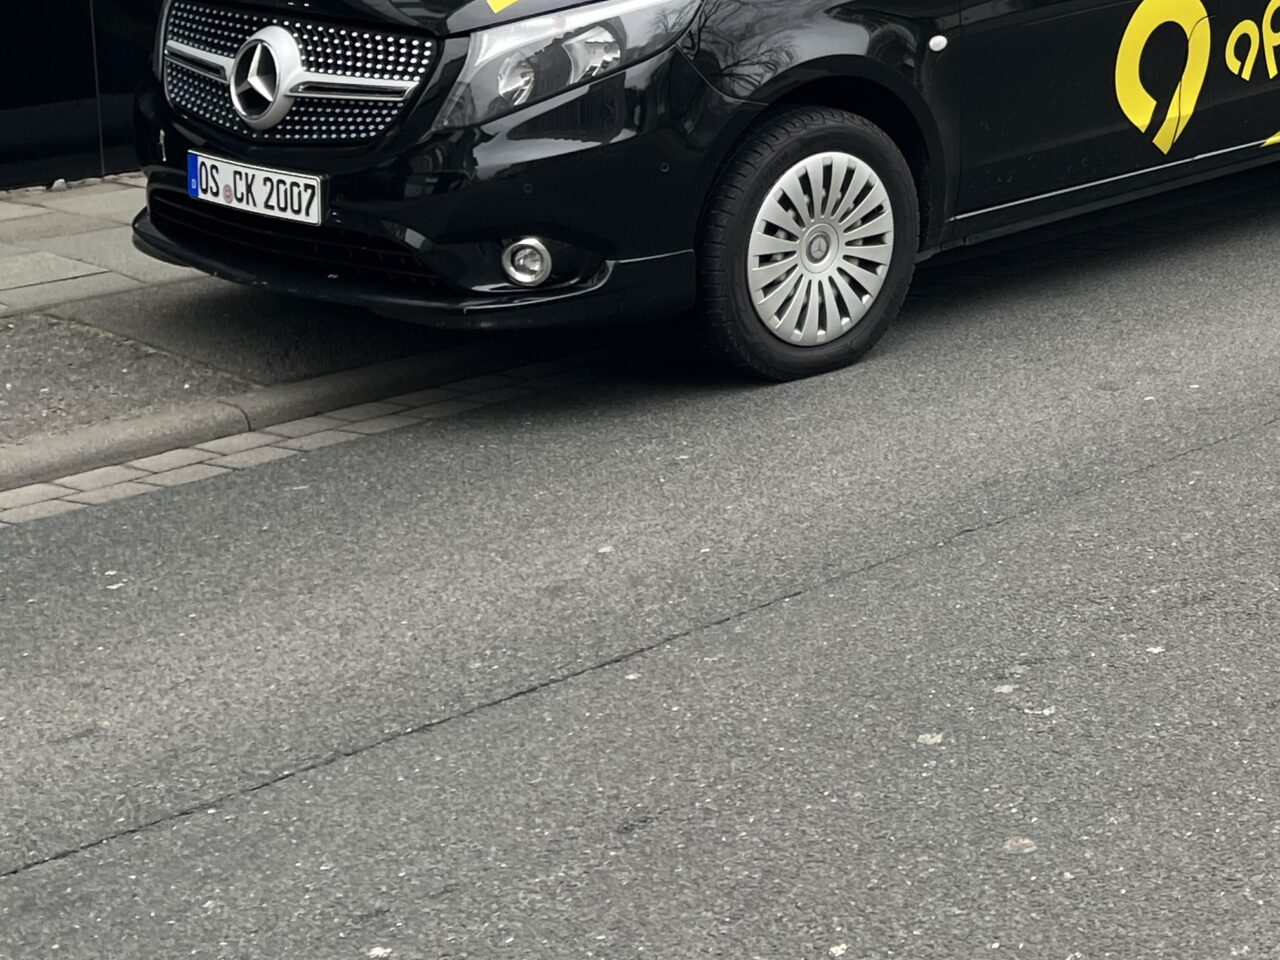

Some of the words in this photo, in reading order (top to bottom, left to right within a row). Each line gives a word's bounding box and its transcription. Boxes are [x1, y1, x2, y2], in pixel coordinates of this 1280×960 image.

[199, 160, 220, 198] OS
[233, 170, 258, 208] CK
[263, 176, 317, 217] 2007
